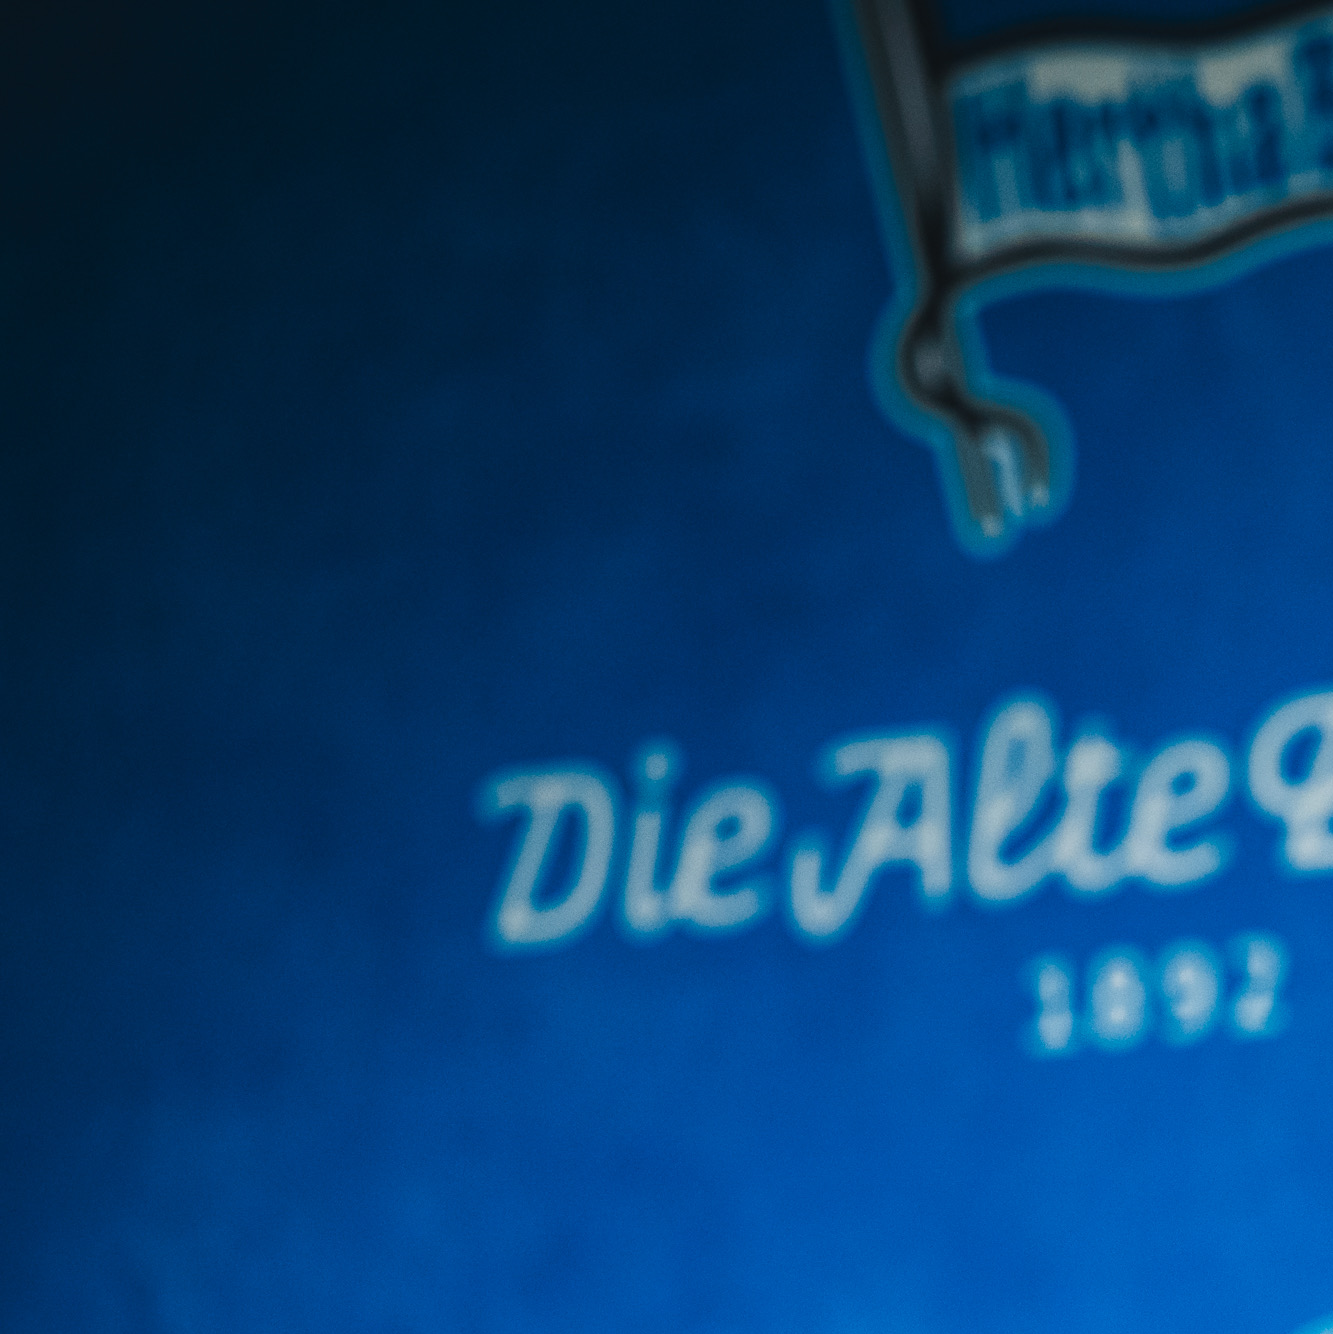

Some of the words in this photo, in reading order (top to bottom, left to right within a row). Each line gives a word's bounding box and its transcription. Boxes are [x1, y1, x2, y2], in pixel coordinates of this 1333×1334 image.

[484, 742, 776, 948] Die
[790, 694, 1233, 940] Alte
[1030, 938, 1286, 1055] 1892
